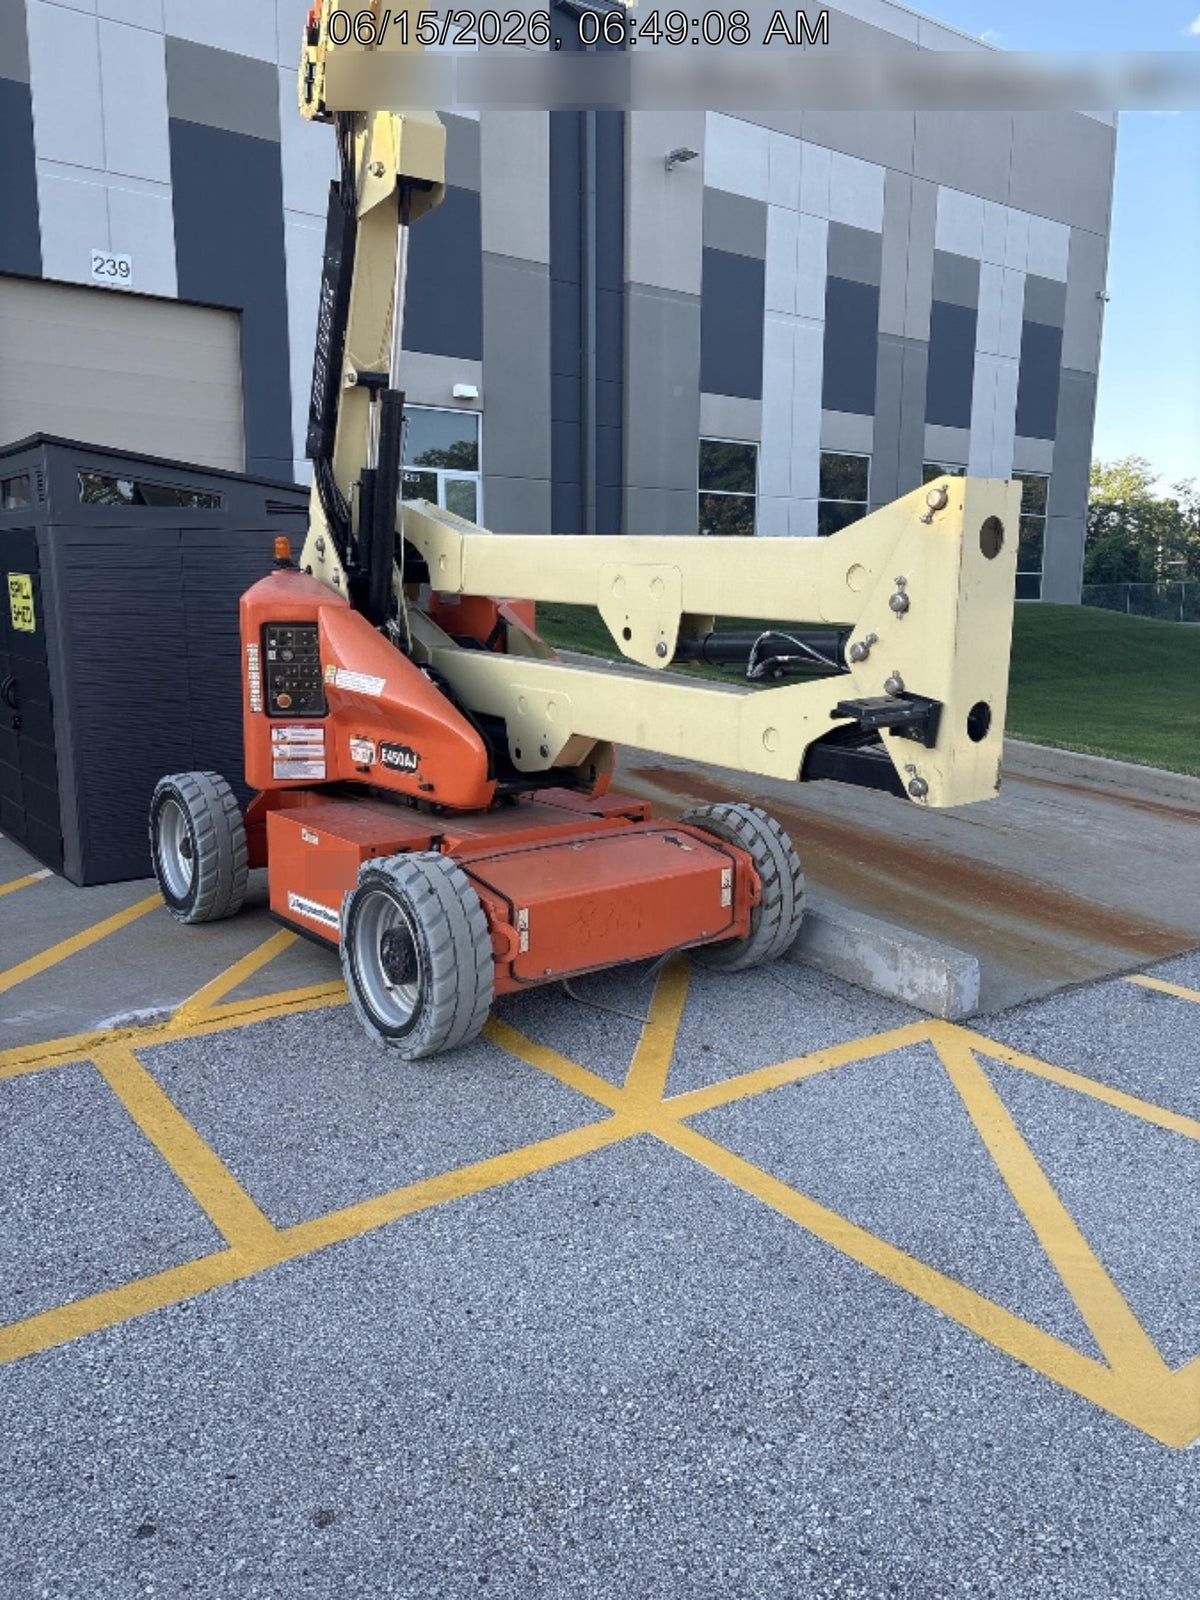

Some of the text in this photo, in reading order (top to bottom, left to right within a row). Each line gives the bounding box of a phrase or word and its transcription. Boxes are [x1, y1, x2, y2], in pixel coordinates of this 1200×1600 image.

[93, 256, 130, 278] 239
[13, 603, 33, 623] SHED
[381, 747, 418, 769] E450AJ
